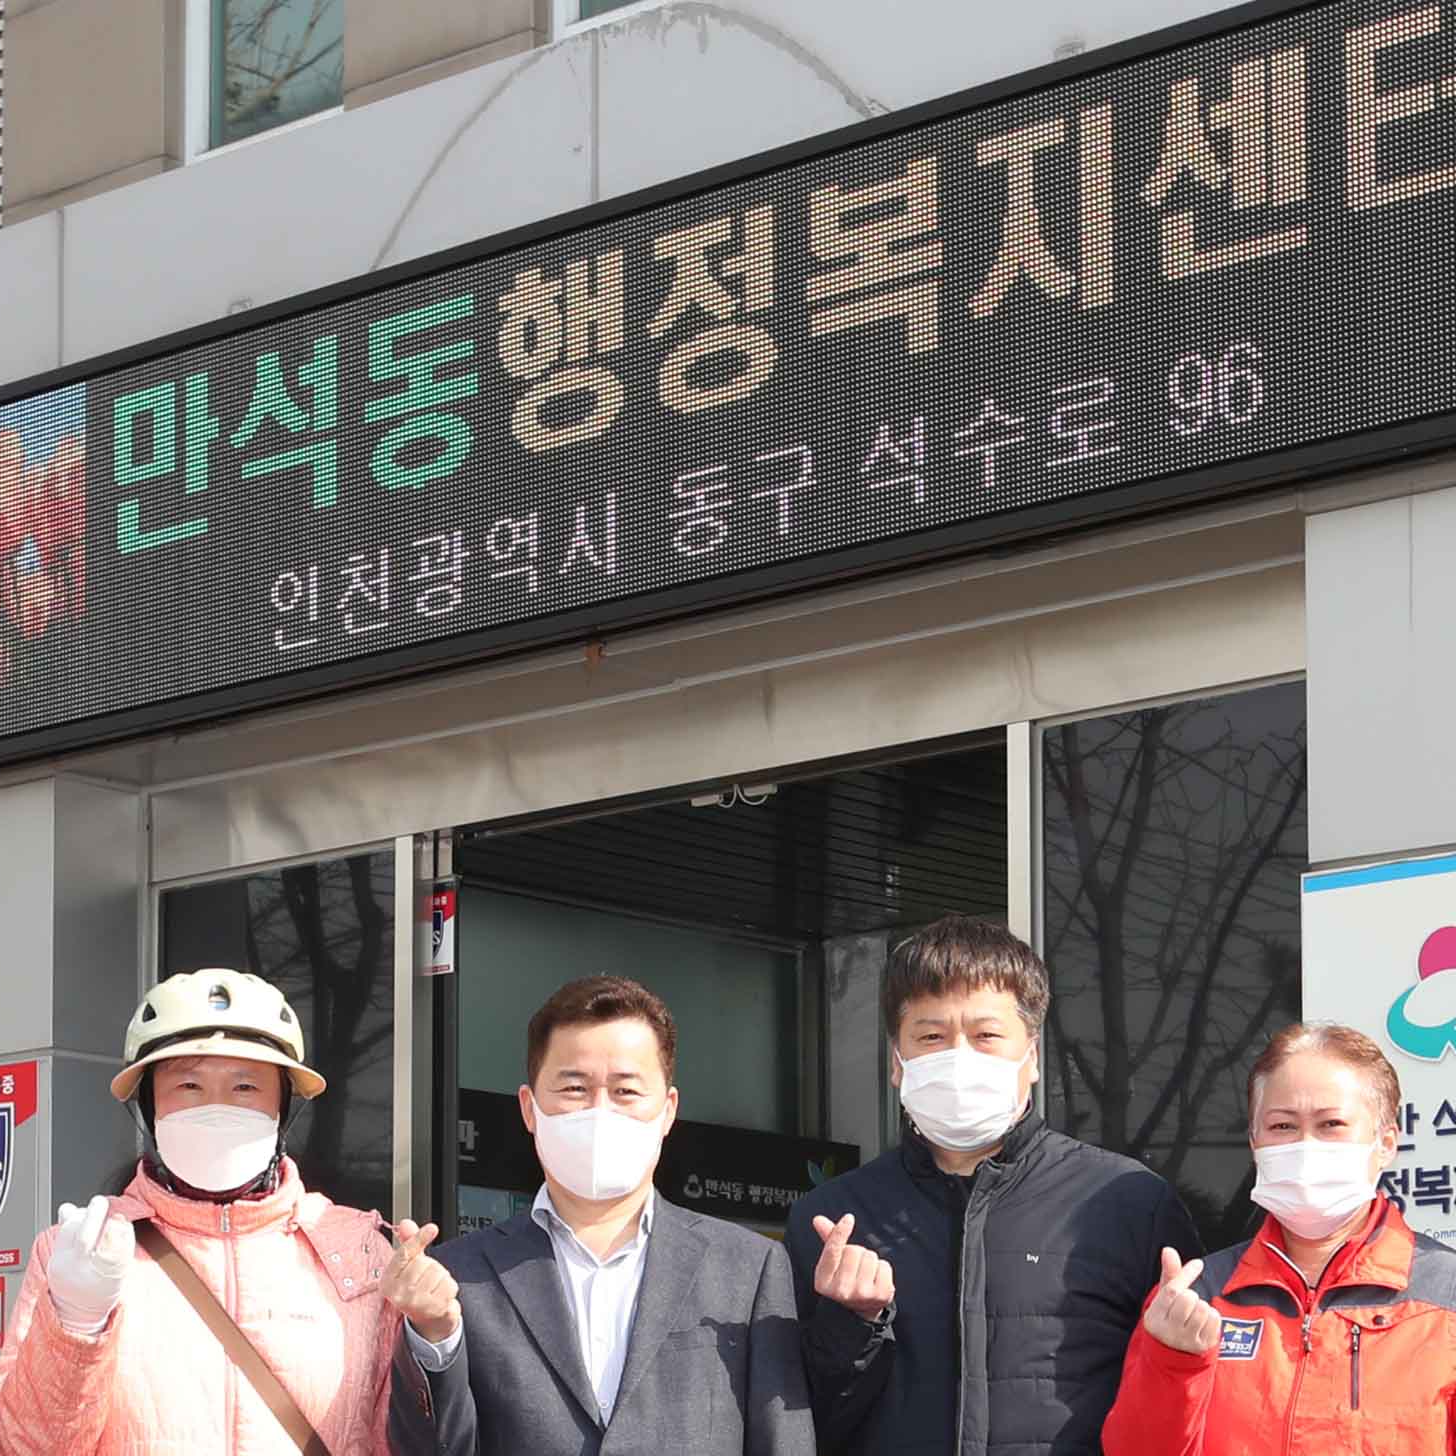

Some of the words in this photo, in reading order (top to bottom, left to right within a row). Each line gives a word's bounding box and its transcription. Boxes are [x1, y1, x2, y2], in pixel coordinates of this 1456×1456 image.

[270, 489, 616, 650] 인천광역시
[671, 440, 817, 558] 동구
[857, 373, 1122, 505] 석수로
[1165, 340, 1264, 438] 96
[748, 1182, 807, 1207] 행정복지
